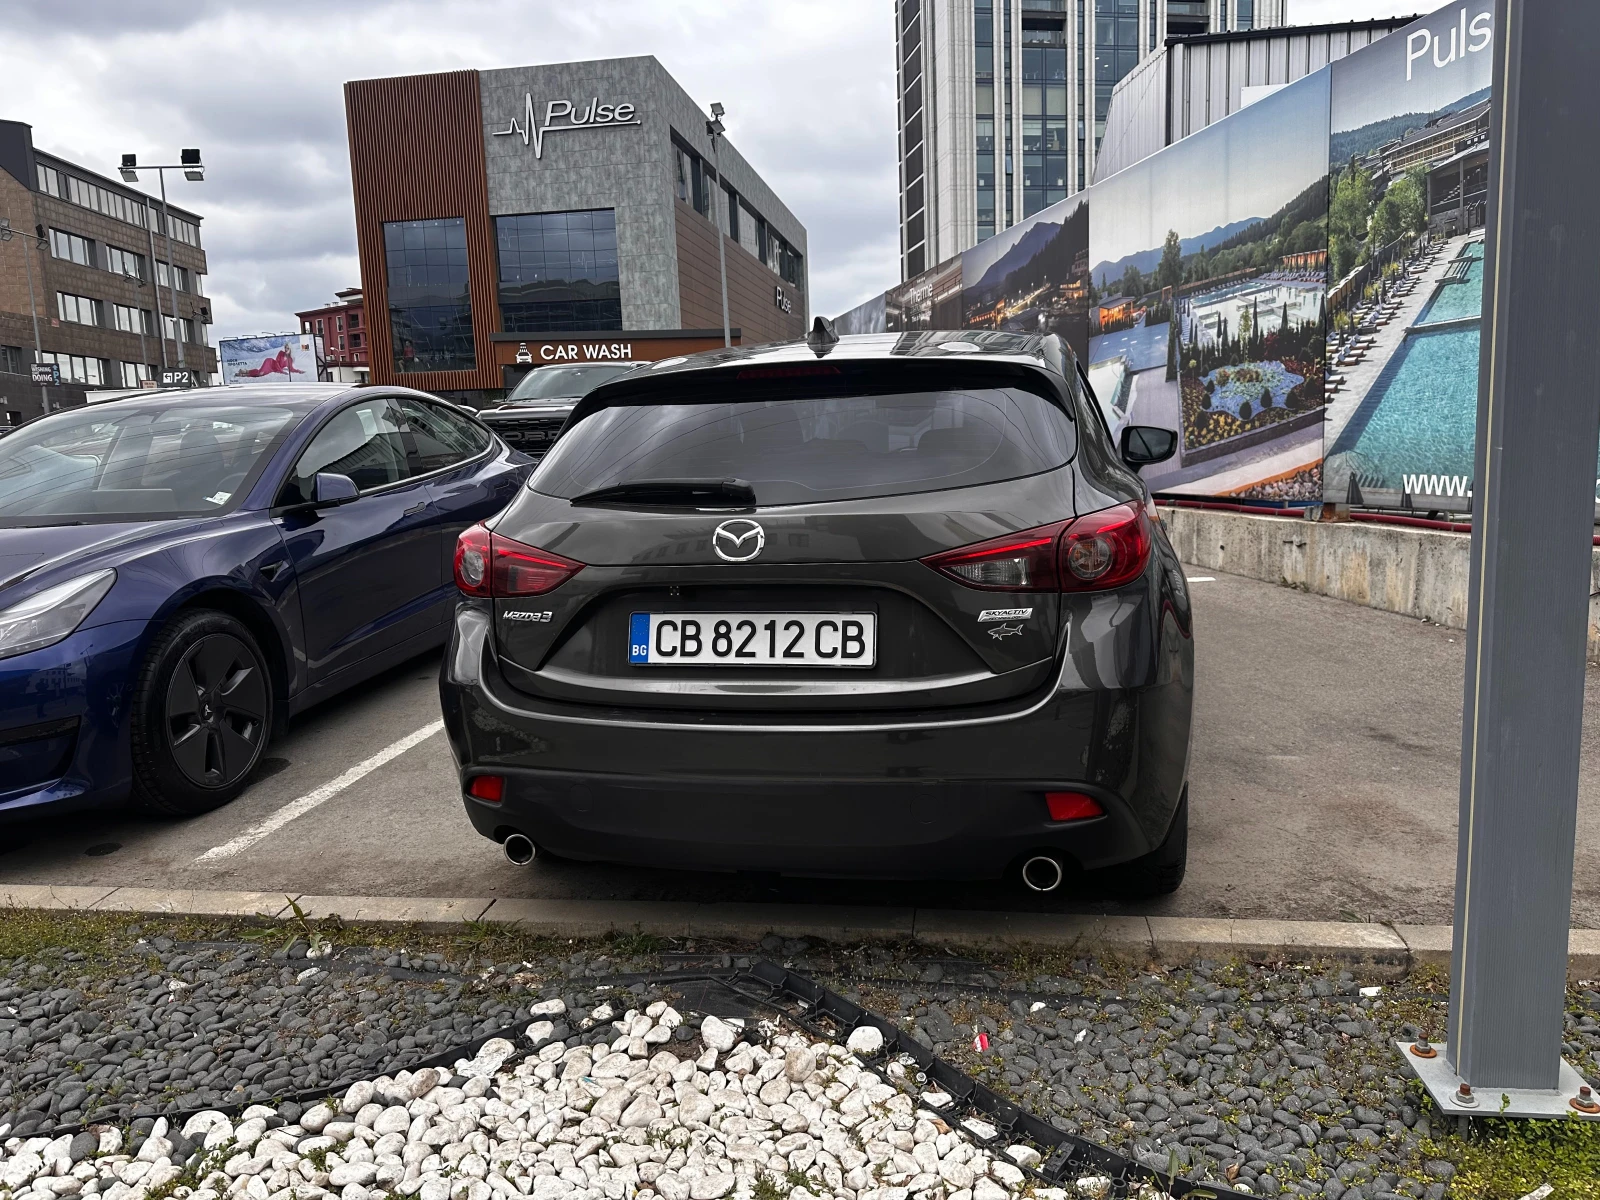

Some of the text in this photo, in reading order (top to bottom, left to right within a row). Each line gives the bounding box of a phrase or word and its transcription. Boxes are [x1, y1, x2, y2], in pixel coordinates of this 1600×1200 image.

[1406, 7, 1492, 81] Puls
[545, 97, 635, 126] Pulse
[776, 286, 792, 314] Pulse
[540, 343, 632, 360] CAR WASH
[174, 371, 189, 383] P2
[1402, 474, 1473, 498] www.
[631, 644, 648, 656] BG
[655, 619, 866, 659] CB 8212 CB
